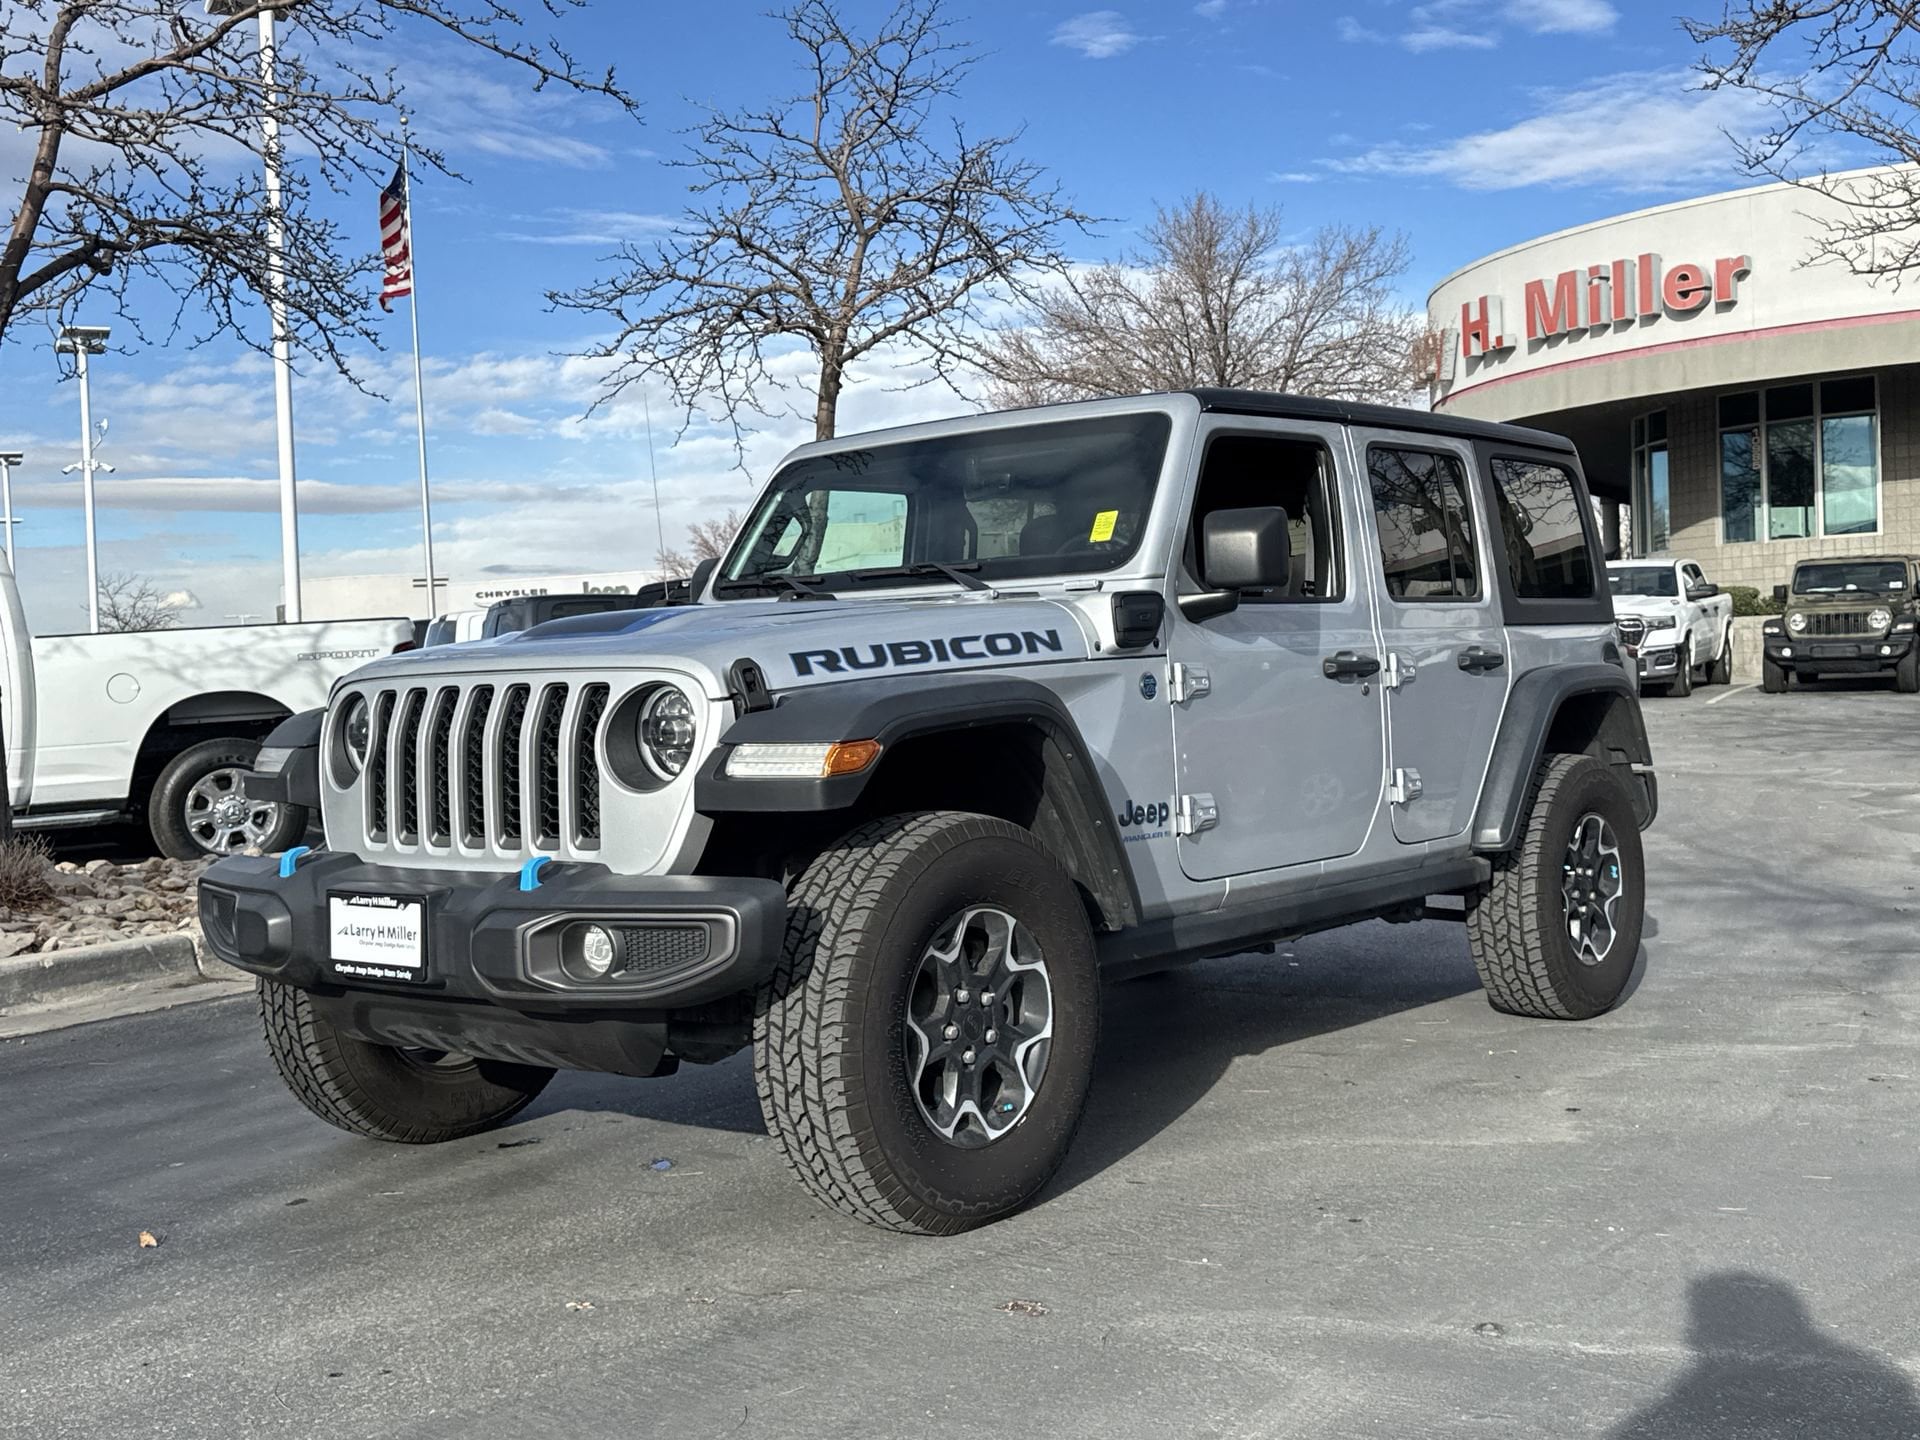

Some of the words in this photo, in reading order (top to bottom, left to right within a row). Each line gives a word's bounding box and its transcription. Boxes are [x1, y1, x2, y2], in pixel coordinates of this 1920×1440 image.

[1460, 294, 1513, 358] H.
[1525, 252, 1752, 341] Miller
[475, 588, 548, 599] CHRYSLER
[296, 648, 380, 662] SPORT
[788, 628, 1063, 677] RUBICON
[1118, 799, 1170, 828] Jeep
[350, 924, 375, 940] Larry
[378, 926, 385, 938] H
[387, 926, 416, 941] Miller
